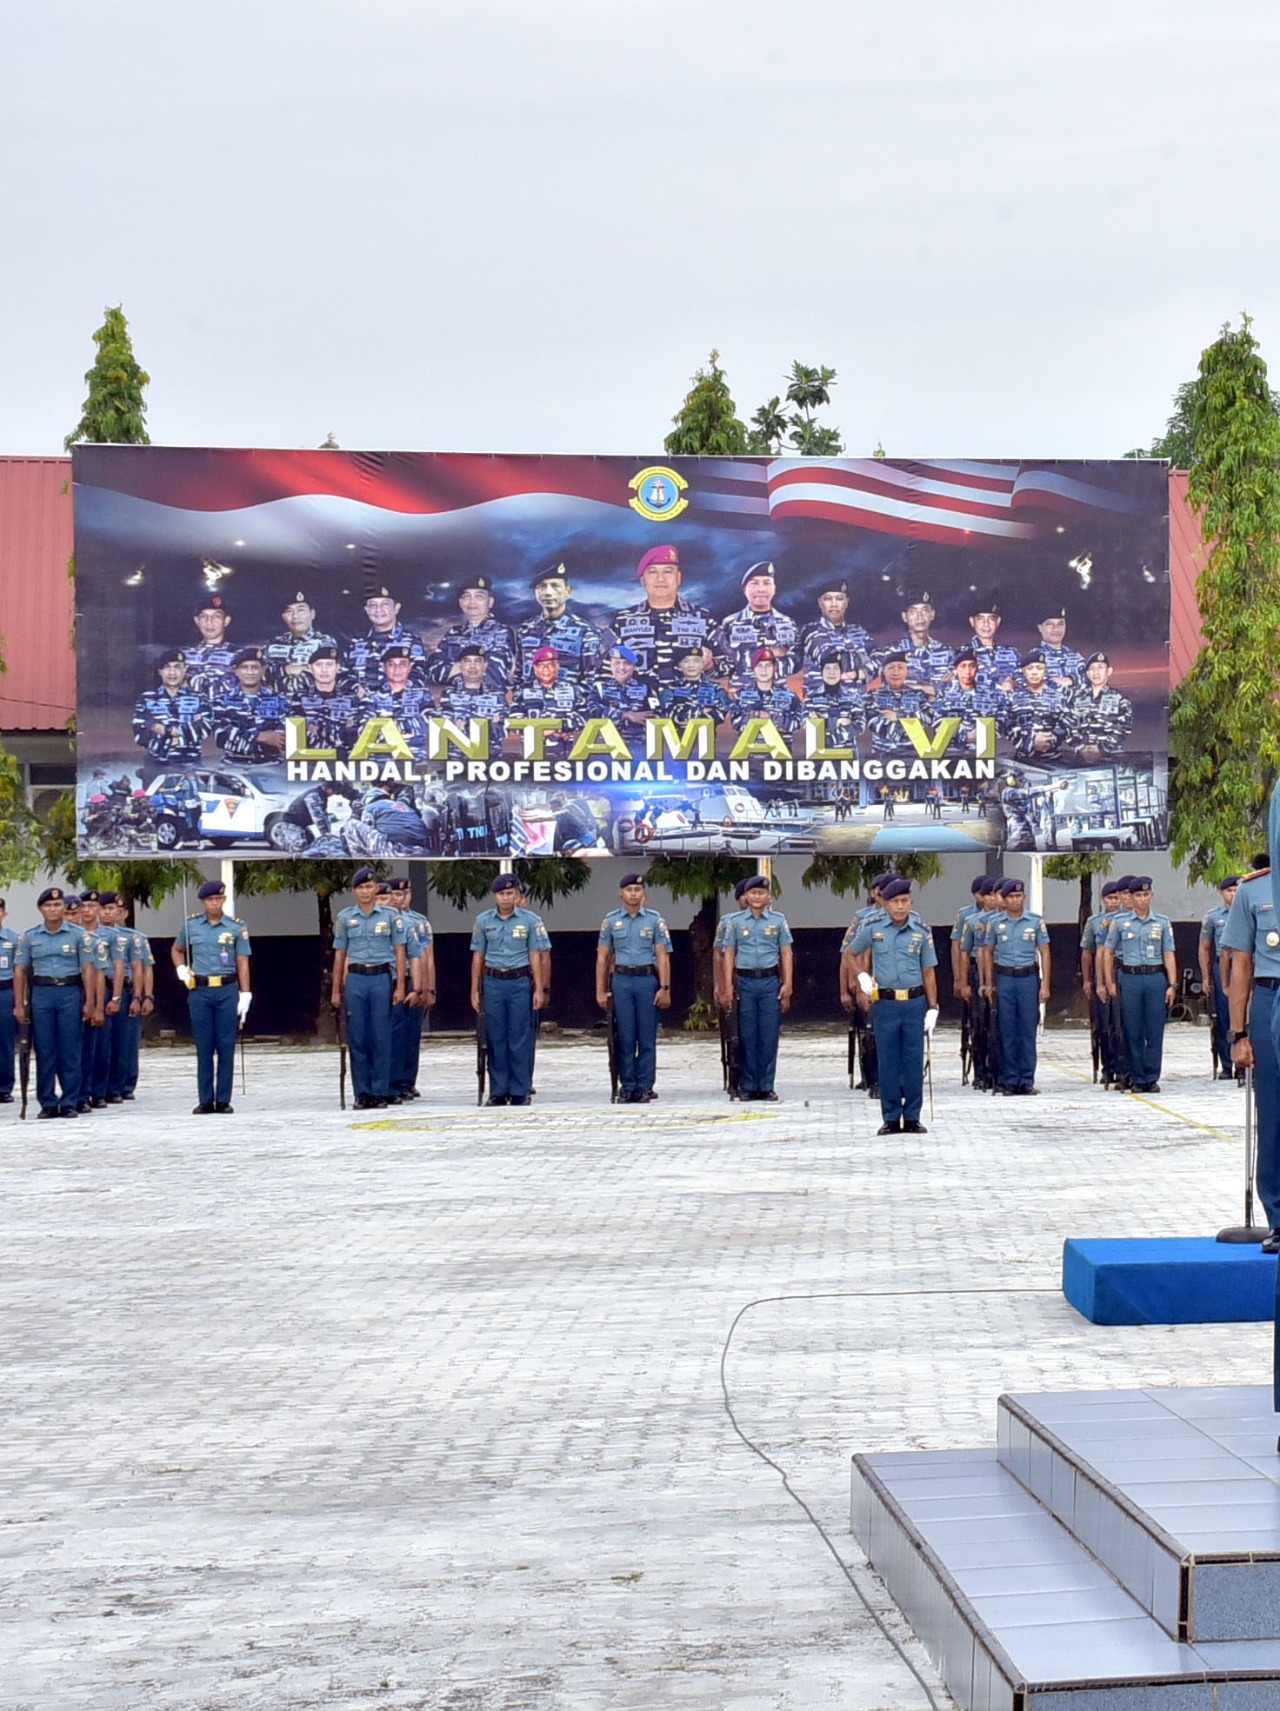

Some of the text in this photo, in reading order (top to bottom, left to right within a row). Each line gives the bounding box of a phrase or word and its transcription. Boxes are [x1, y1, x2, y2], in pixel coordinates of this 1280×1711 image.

[285, 717, 996, 760] LANTAMAL VI
[286, 759, 996, 783] HANDAL, PROFESIONAL DAN DIBANGGAKAN
